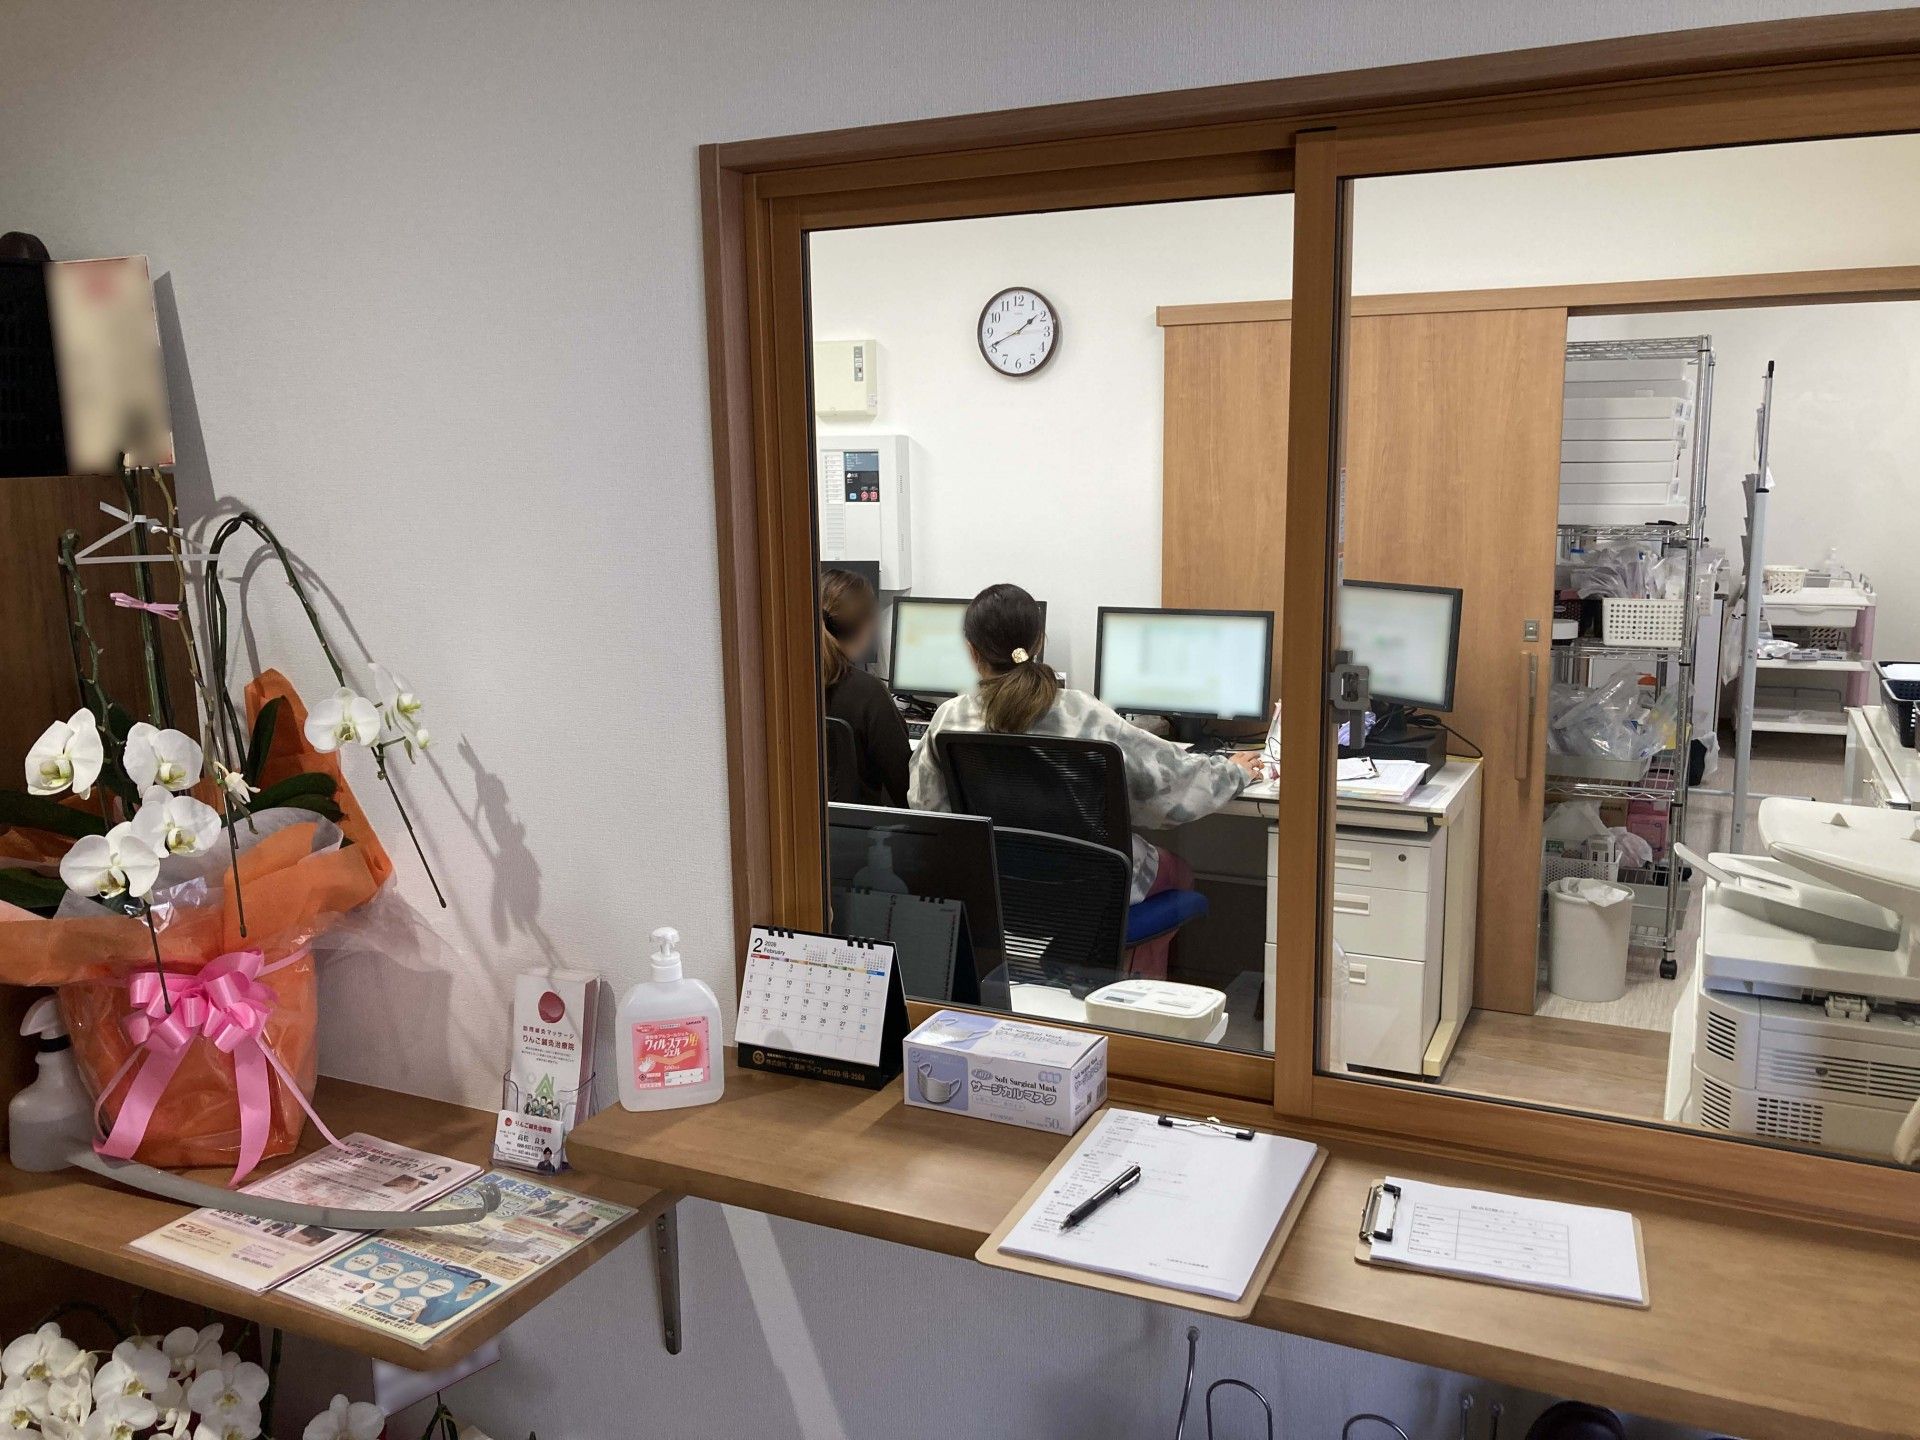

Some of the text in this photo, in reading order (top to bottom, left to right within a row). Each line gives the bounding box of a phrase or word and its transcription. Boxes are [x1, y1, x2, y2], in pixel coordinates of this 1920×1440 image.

[1001, 301, 1009, 311] 11
[1013, 295, 1024, 306] 12
[1031, 300, 1035, 310] 1
[991, 312, 1000, 323] 10
[1040, 311, 1046, 322] 2
[987, 327, 994, 338] 9
[1043, 326, 1051, 337] 3
[991, 343, 998, 353] 8
[1002, 354, 1008, 365] 7
[1015, 358, 1022, 369] 6
[1029, 354, 1036, 364] 5
[752, 937, 763, 953] 2
[764, 947, 785, 956] February
[995, 1075, 1008, 1083] Soft
[1010, 1078, 1037, 1089] Surgical
[1038, 1083, 1057, 1093] Mask
[971, 1080, 1057, 1106] サージカルマスク
[480, 1173, 552, 1200] 健康保険
